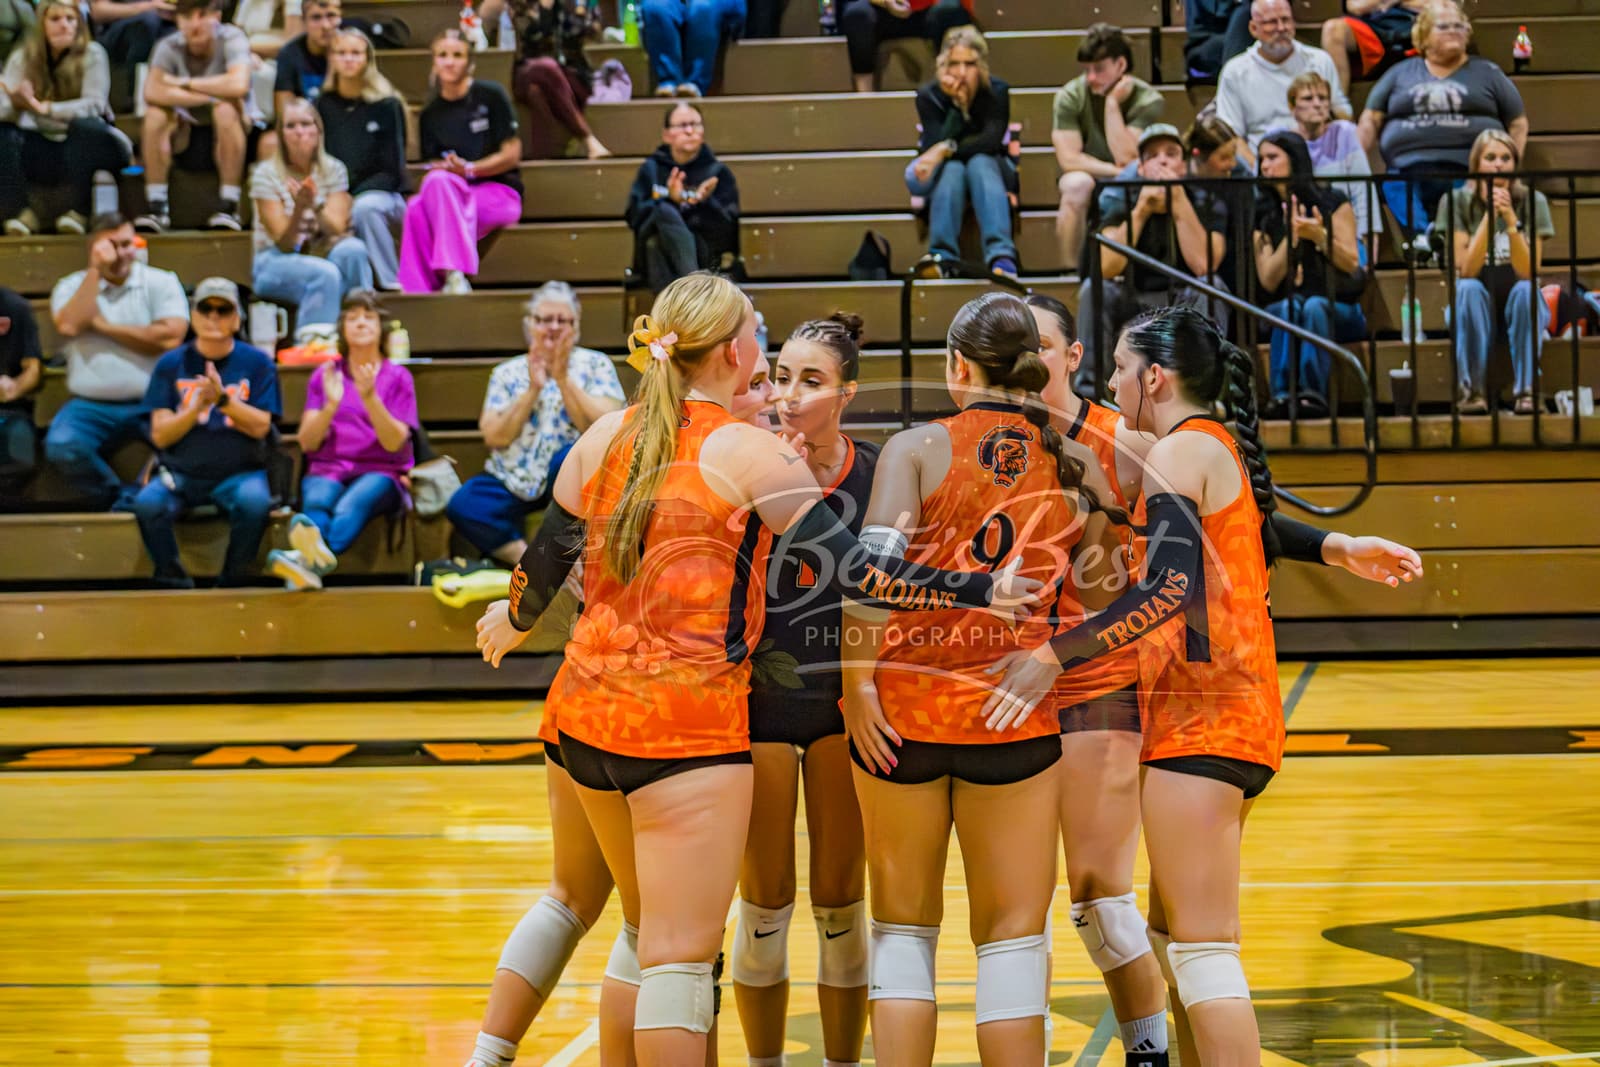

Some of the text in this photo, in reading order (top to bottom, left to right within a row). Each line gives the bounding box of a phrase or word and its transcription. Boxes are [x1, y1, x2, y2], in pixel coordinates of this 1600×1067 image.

[970, 510, 1016, 574] 9
[858, 563, 957, 612] TROJANS
[1097, 568, 1189, 650] TROJANS
